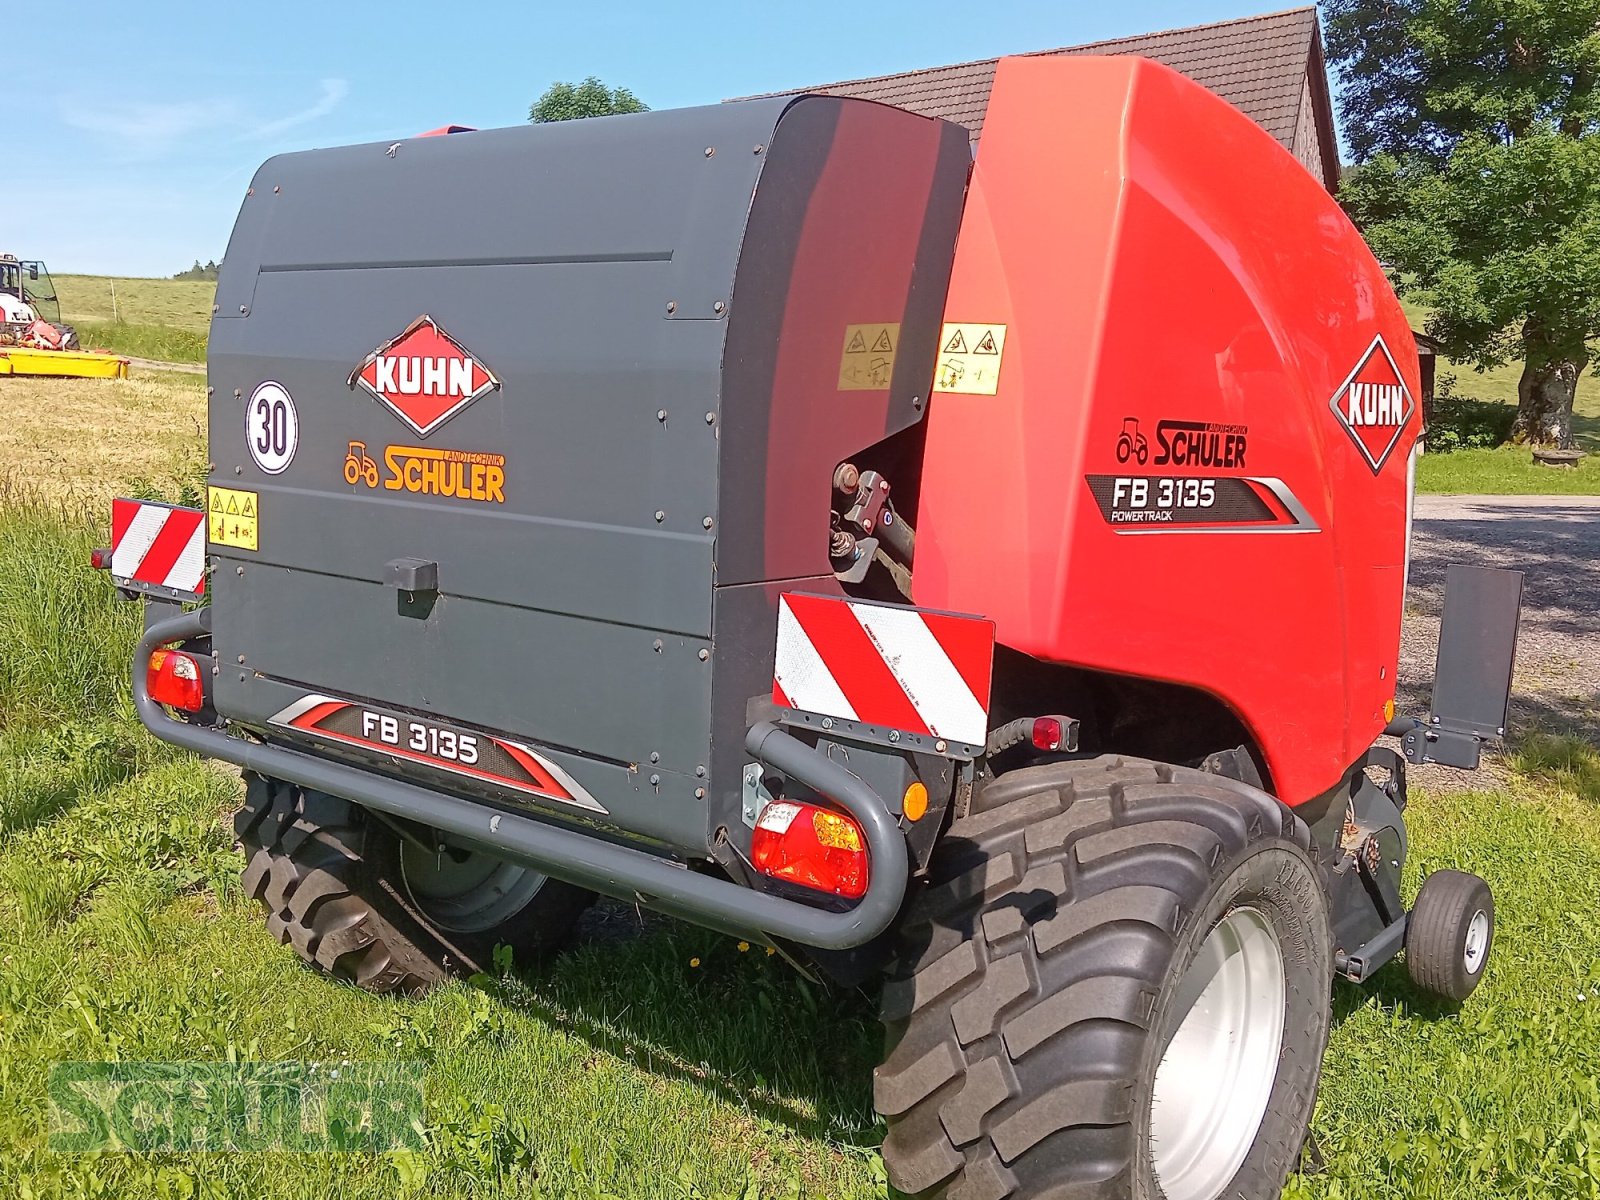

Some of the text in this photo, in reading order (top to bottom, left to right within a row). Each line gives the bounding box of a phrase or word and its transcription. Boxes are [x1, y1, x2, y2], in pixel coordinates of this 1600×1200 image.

[375, 355, 474, 398] KUHN
[256, 398, 287, 456] 30
[1347, 381, 1403, 427] KUHN
[1153, 419, 1248, 469] SCHULER
[384, 445, 505, 503] SCHULER
[1111, 478, 1216, 509] FB 3135
[1110, 510, 1174, 523] POWERTRACK
[361, 710, 479, 765] FB 3135
